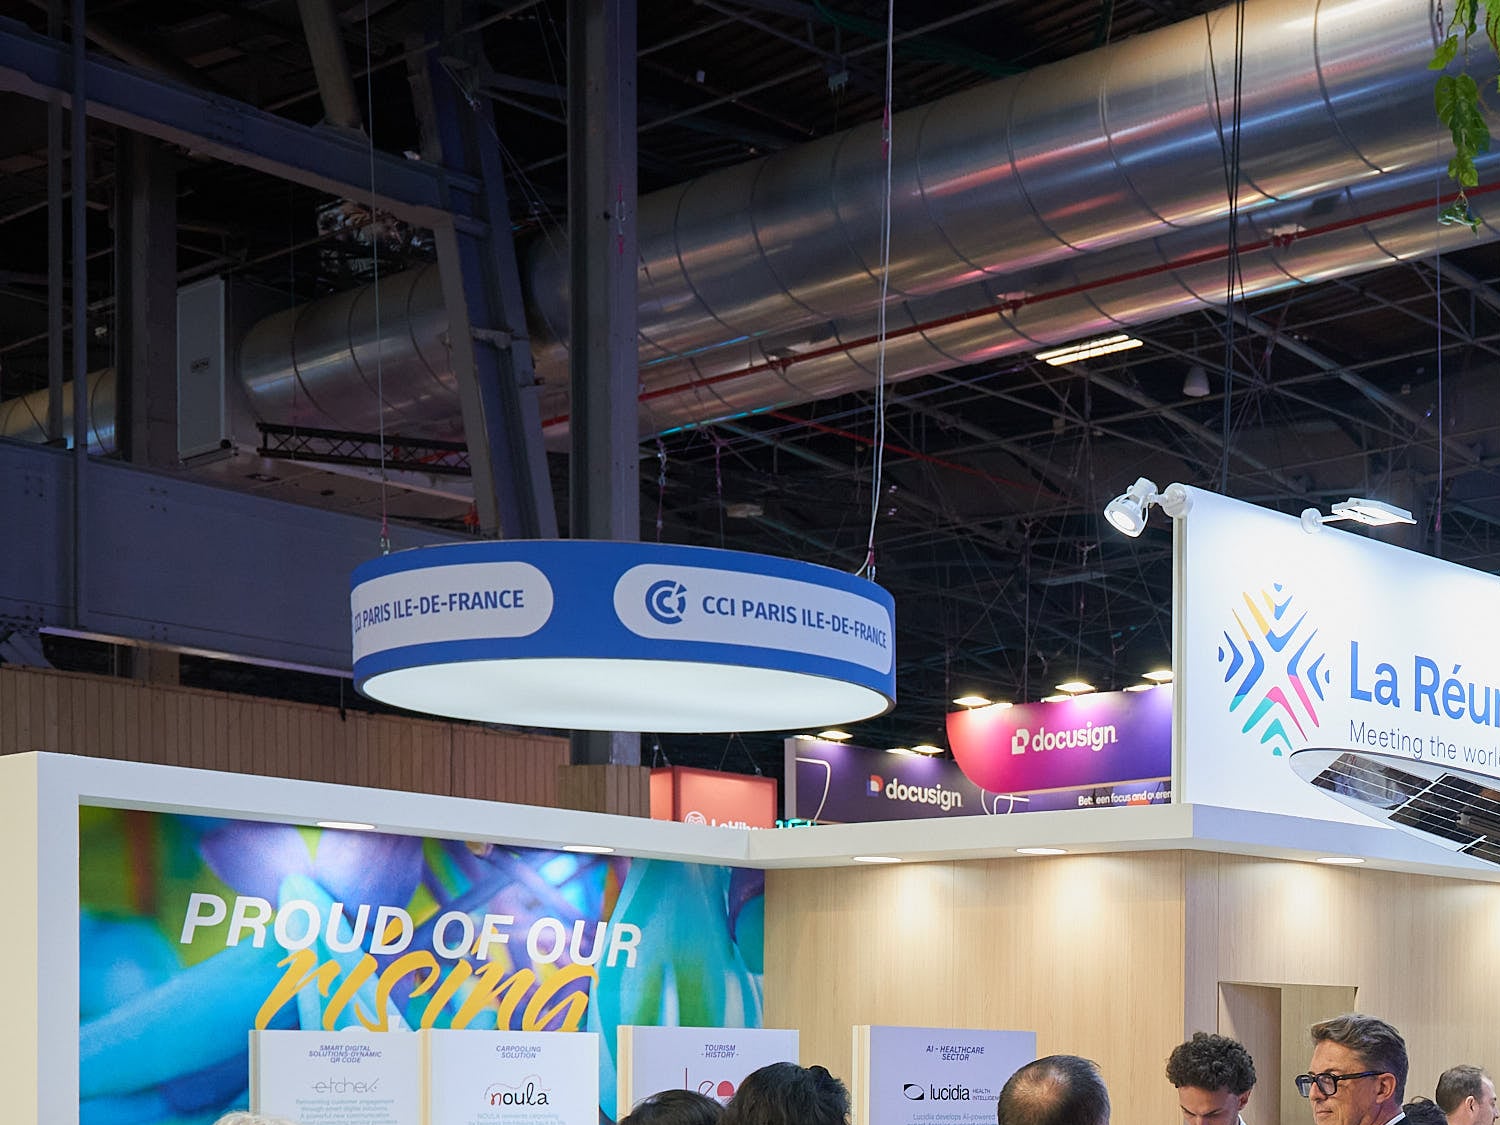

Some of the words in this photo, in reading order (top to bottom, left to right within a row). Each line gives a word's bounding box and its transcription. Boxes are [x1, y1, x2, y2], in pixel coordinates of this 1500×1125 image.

[362, 602, 391, 628] PARIS
[394, 590, 524, 620] ILE-DE-FRANCE
[702, 594, 735, 616] CCI
[742, 600, 797, 624] PARIS
[802, 608, 887, 649] ILE-DE-FRANCE
[1350, 640, 1400, 708] La
[1032, 722, 1116, 753] docusign
[1348, 718, 1423, 760] Meeting
[1430, 734, 1458, 760] the
[886, 778, 962, 812] docusign
[1078, 794, 1110, 806] Beteen
[1110, 792, 1132, 804] focus
[1132, 790, 1147, 802] and
[180, 892, 414, 956] PROUD
[432, 910, 514, 962] OF
[526, 918, 643, 970] OUR
[320, 1044, 344, 1052] SMART
[344, 1044, 370, 1052] DIGITAL
[704, 1044, 736, 1052] TOURISM
[926, 1045, 934, 1053] AI
[940, 1046, 985, 1054] HEALTHCARE
[490, 1082, 550, 1106] noula
[930, 1083, 970, 1101] lucidia
